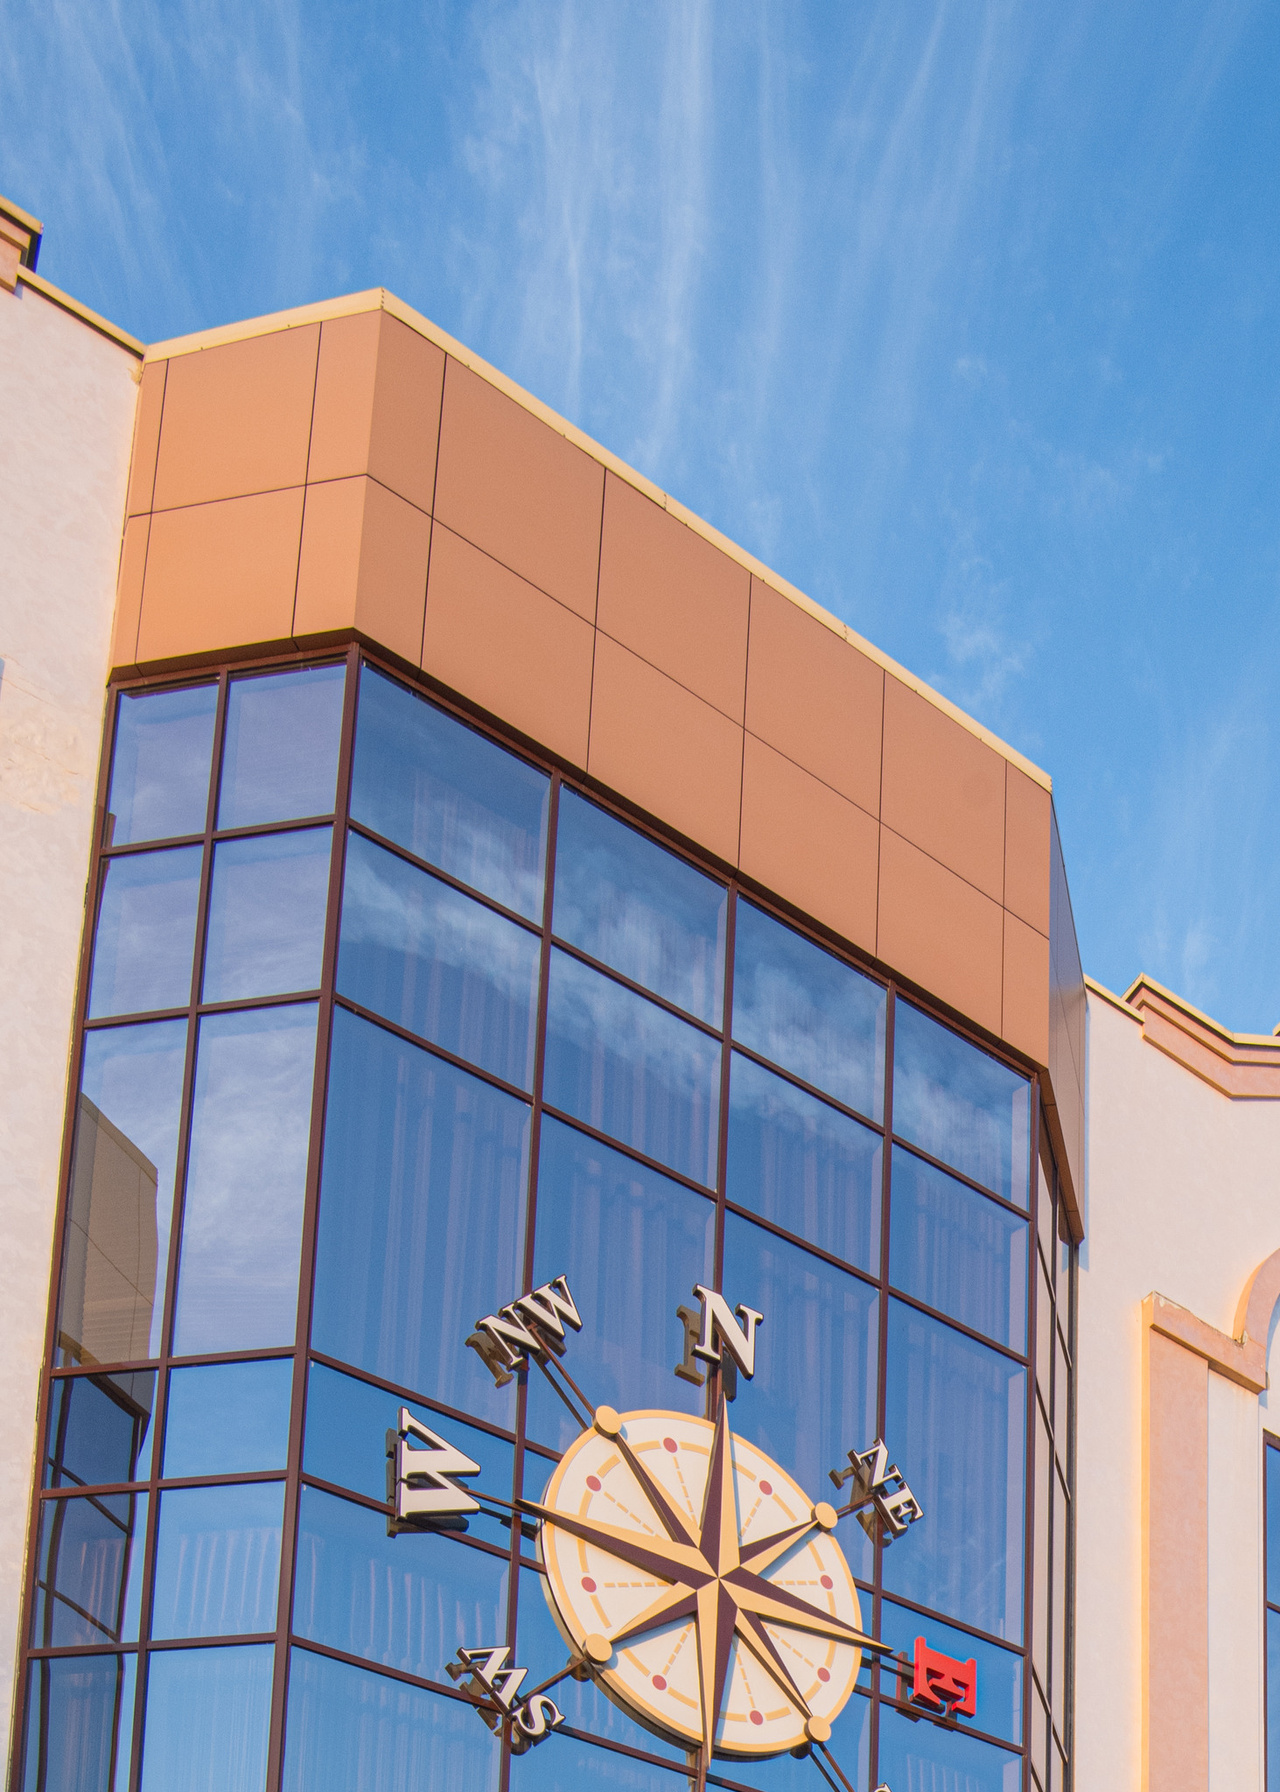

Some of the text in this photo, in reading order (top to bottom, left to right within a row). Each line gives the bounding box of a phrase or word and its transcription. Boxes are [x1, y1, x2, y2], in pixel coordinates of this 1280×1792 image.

[476, 1275, 583, 1370] NW
[693, 1283, 764, 1380] N
[395, 1406, 481, 1521] W
[847, 1439, 924, 1538] NE
[912, 1636, 977, 1717] E
